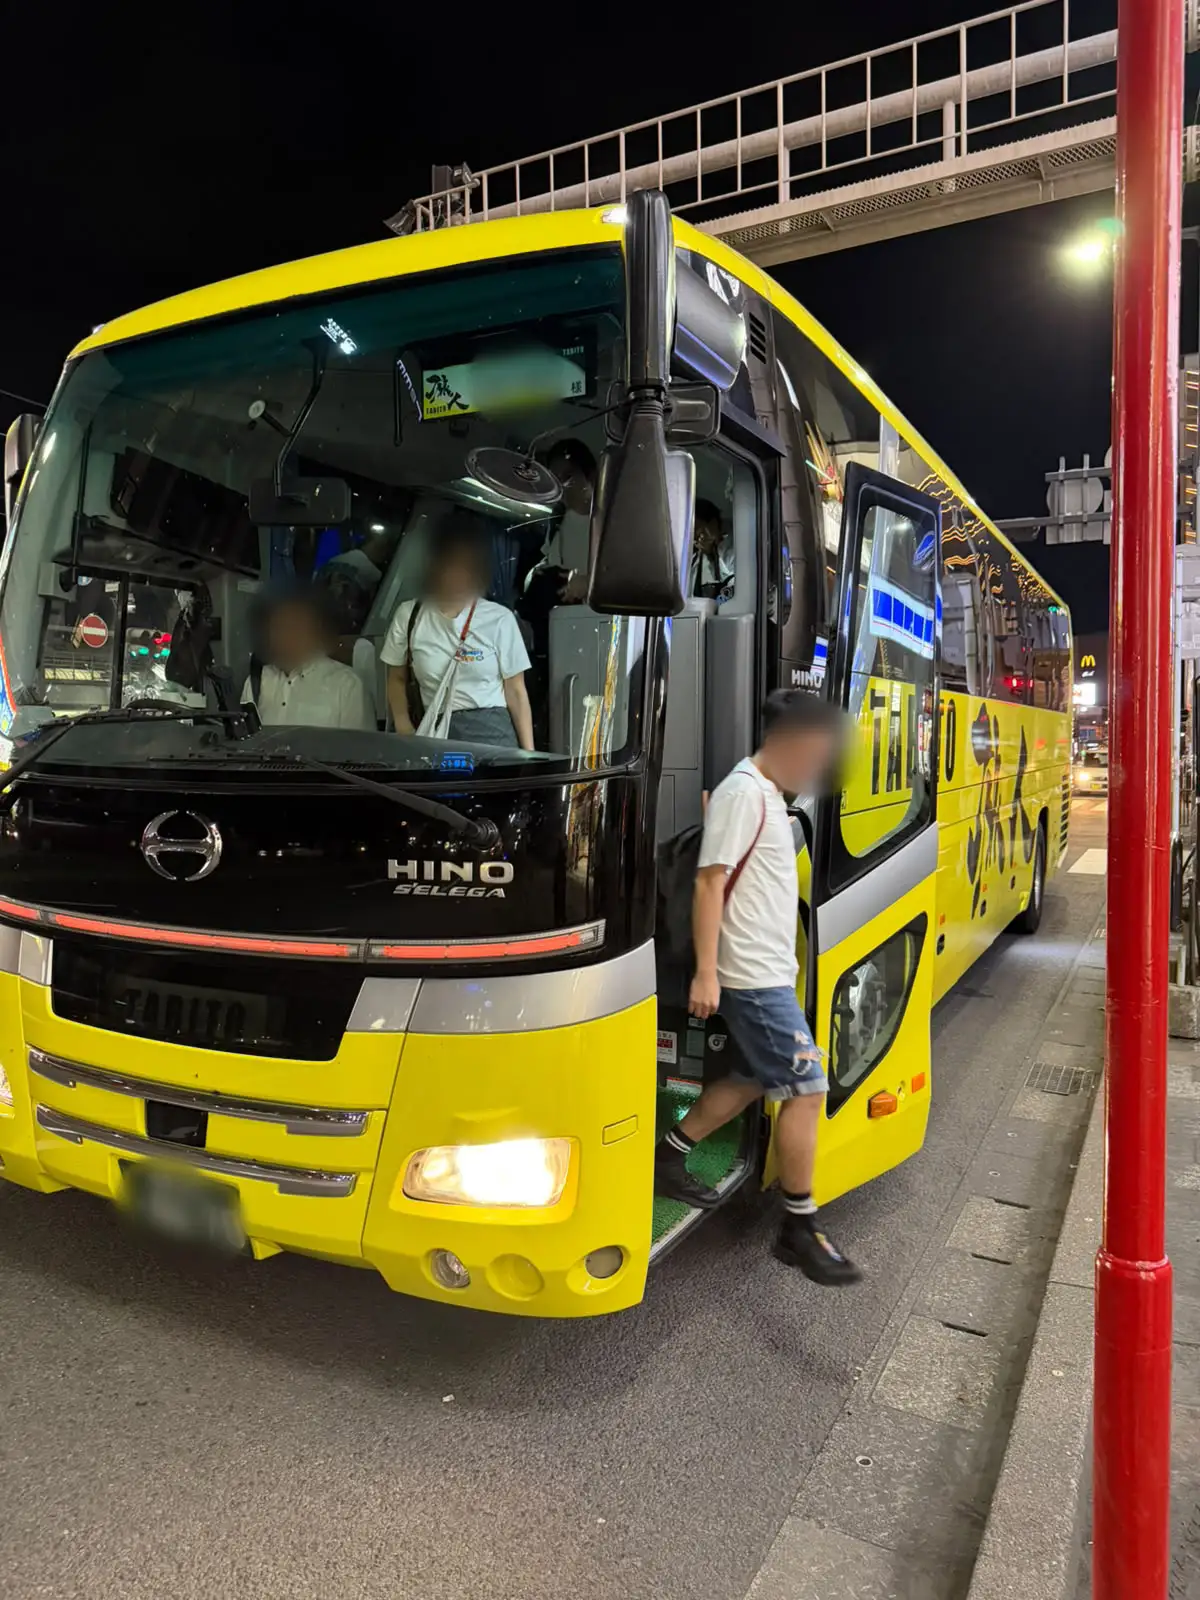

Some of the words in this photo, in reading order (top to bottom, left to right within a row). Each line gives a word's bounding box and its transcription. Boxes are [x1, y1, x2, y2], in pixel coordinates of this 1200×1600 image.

[791, 668, 823, 688] HINO
[387, 858, 515, 884] HINO
[392, 882, 507, 898] SELEGA
